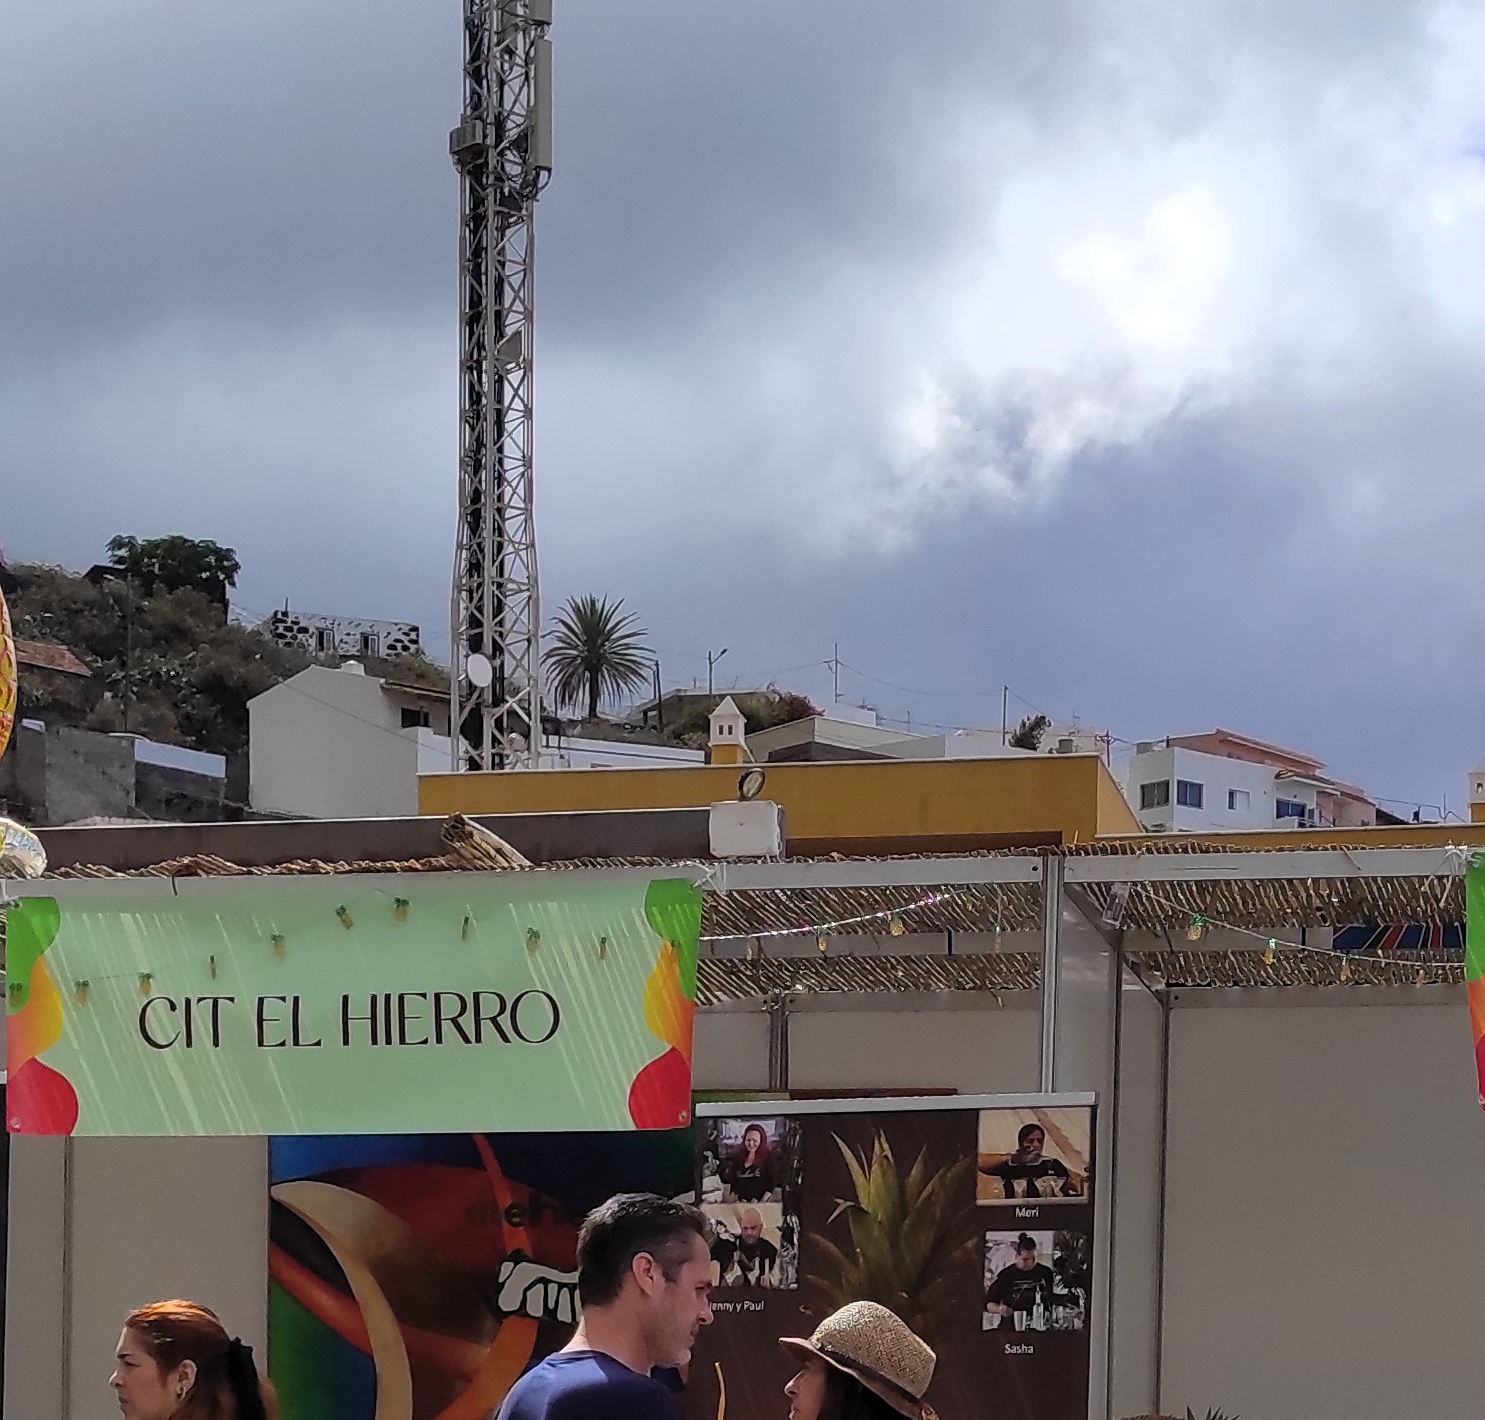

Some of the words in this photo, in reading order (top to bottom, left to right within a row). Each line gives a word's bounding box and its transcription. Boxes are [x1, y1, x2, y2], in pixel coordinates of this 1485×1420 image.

[138, 994, 235, 1050] CIT
[256, 993, 322, 1048] EL
[340, 988, 561, 1048] HIERRO
[744, 1300, 765, 1311] Paul
[1004, 1342, 1034, 1356] Sasha
